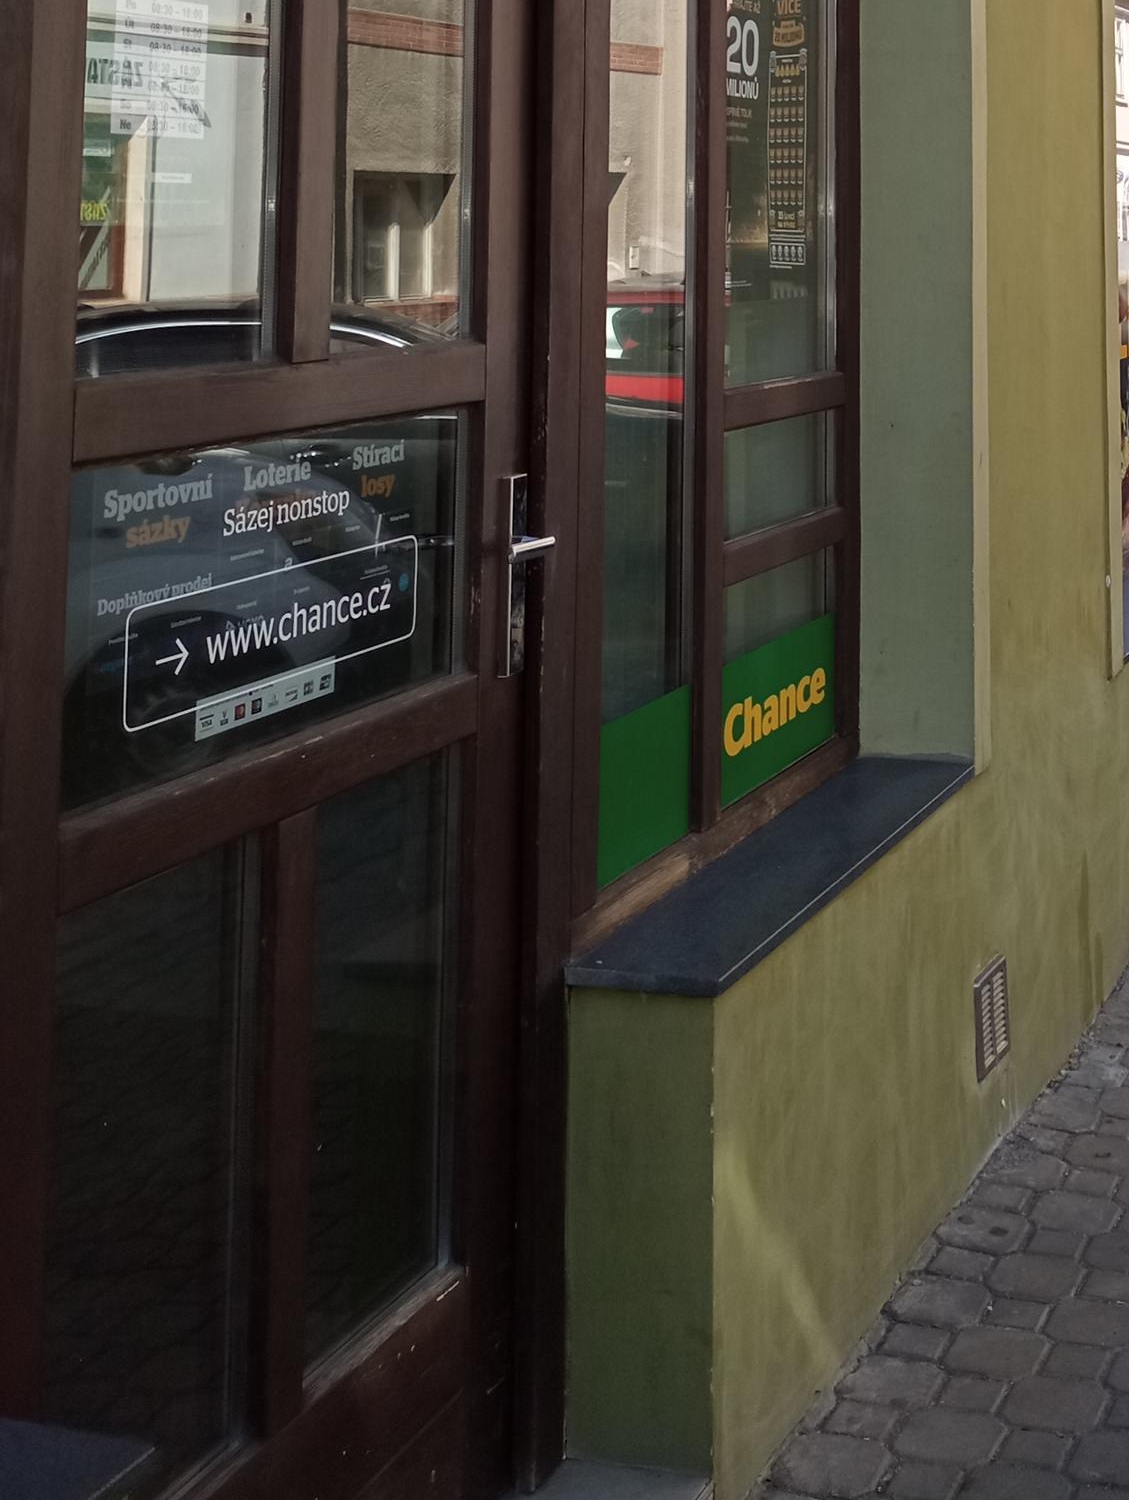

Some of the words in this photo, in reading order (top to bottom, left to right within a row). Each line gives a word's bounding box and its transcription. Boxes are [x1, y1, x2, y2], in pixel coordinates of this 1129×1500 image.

[727, 16, 759, 76] 20
[104, 473, 213, 521] Sportovní
[244, 460, 311, 492] Loterie
[361, 473, 396, 498] losy
[126, 515, 191, 548] sázky
[223, 500, 273, 537] Sázej
[276, 490, 350, 525] nonstop
[206, 584, 392, 664] www.chance.cz
[724, 668, 826, 756] Chance
